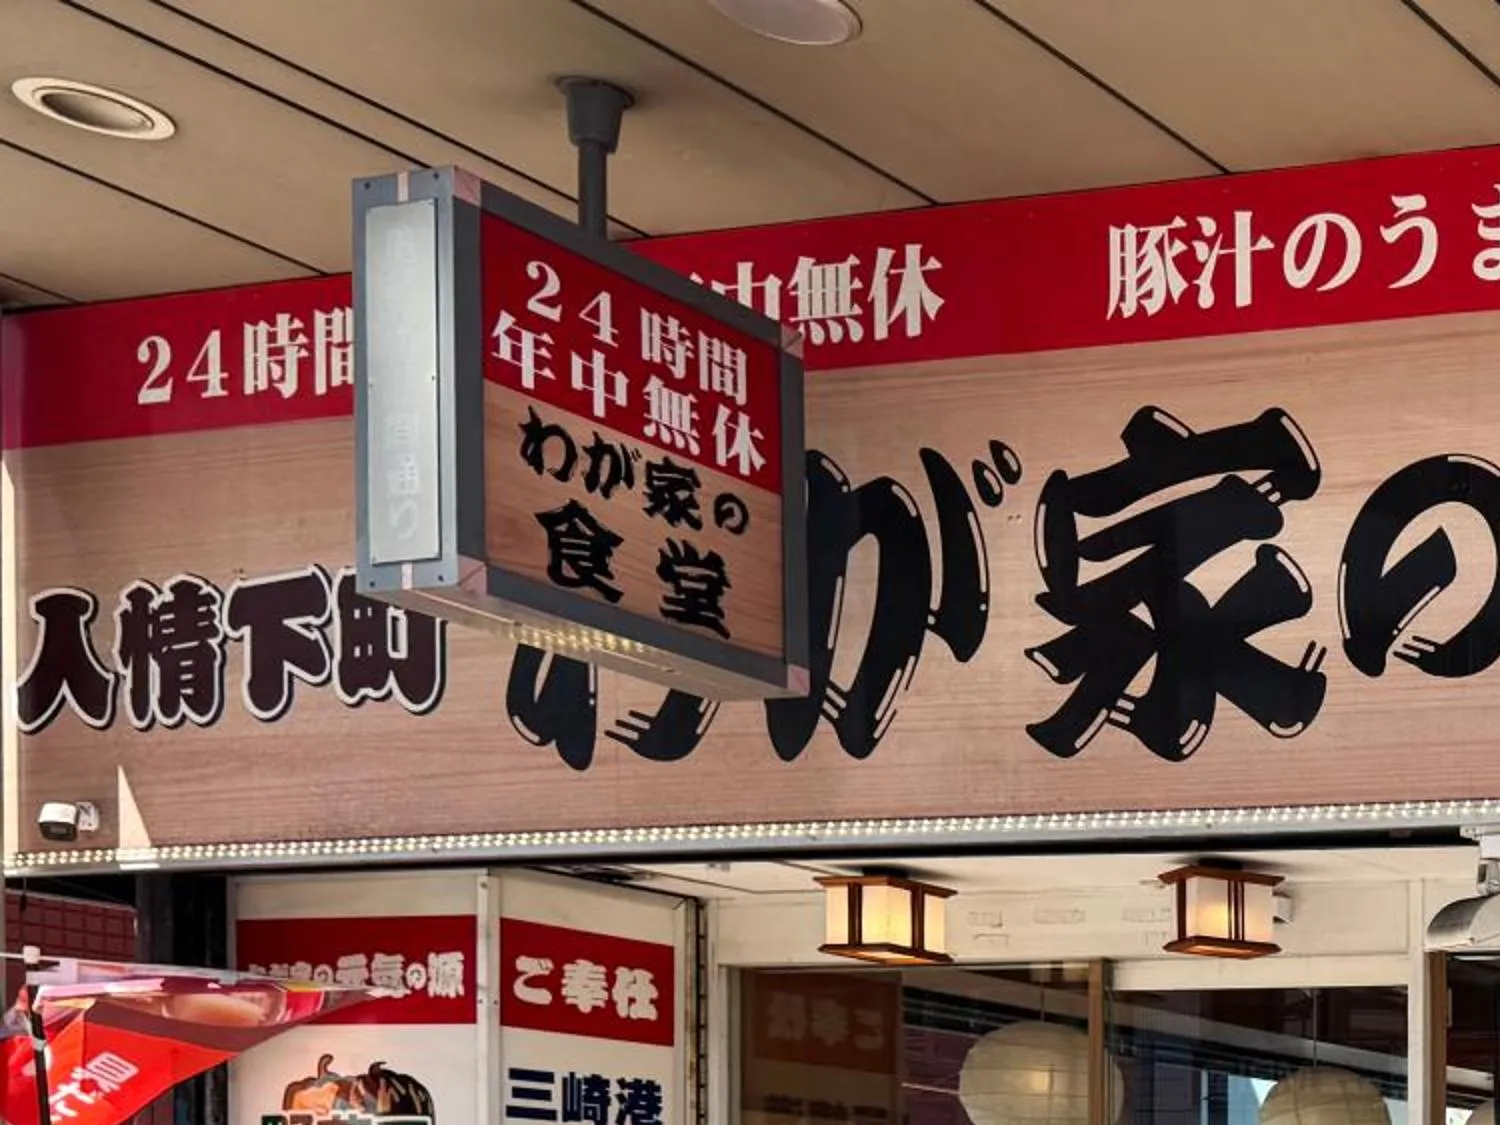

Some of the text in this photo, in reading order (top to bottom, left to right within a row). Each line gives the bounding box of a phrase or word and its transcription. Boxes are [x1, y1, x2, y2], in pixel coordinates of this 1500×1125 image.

[526, 260, 749, 407] 24時間
[686, 243, 945, 345] 中無休
[490, 314, 766, 479] 年中無休
[518, 406, 750, 537] わが家の
[535, 498, 732, 641] 食堂
[15, 564, 447, 735] 人情下町
[512, 956, 658, 1021] ご奉仕
